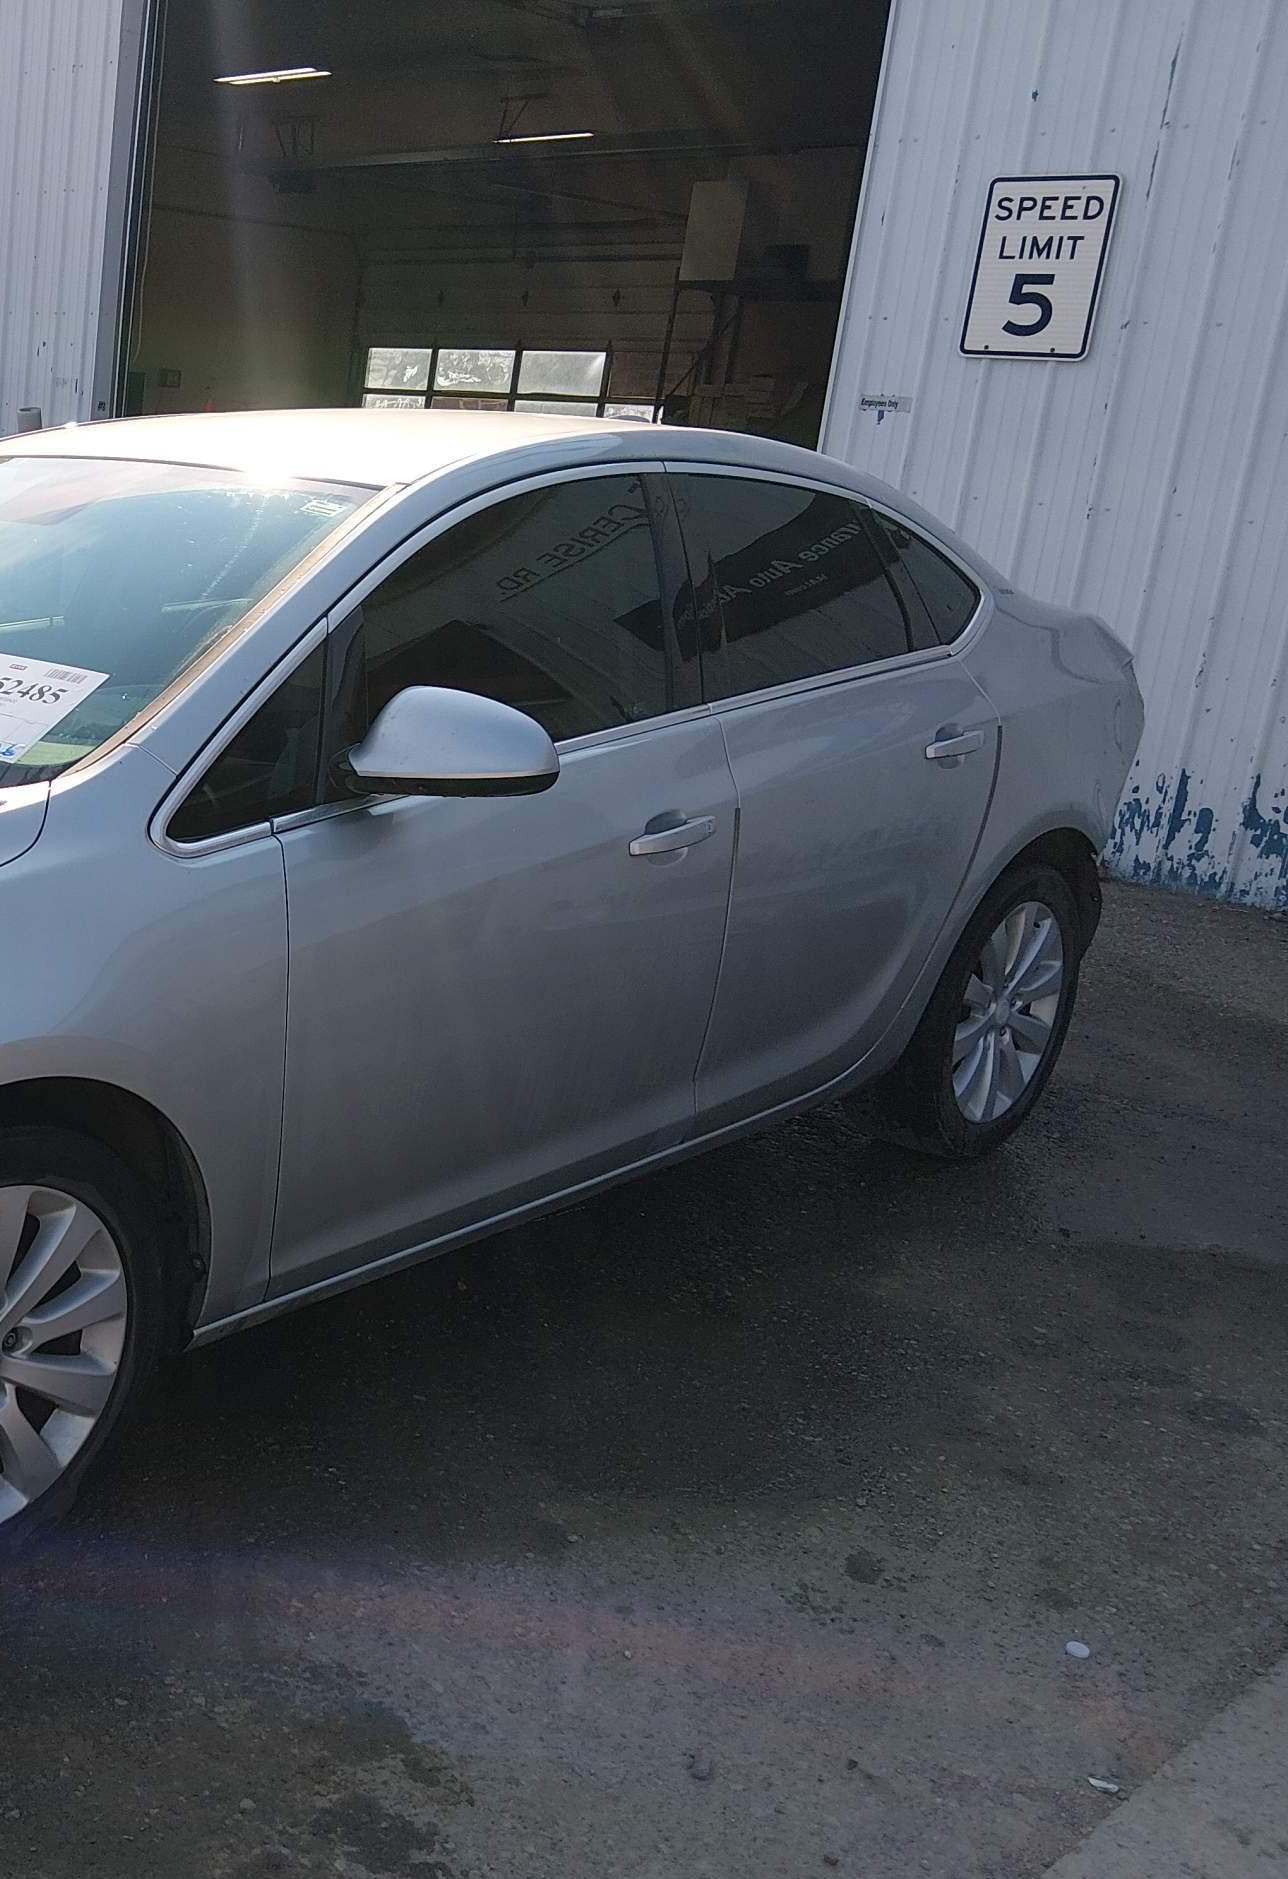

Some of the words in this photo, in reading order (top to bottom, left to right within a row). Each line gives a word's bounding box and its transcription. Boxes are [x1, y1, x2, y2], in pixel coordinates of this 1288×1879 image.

[994, 196, 1104, 221] SPEED
[998, 235, 1085, 260] LIMIT
[1001, 273, 1056, 337] 5
